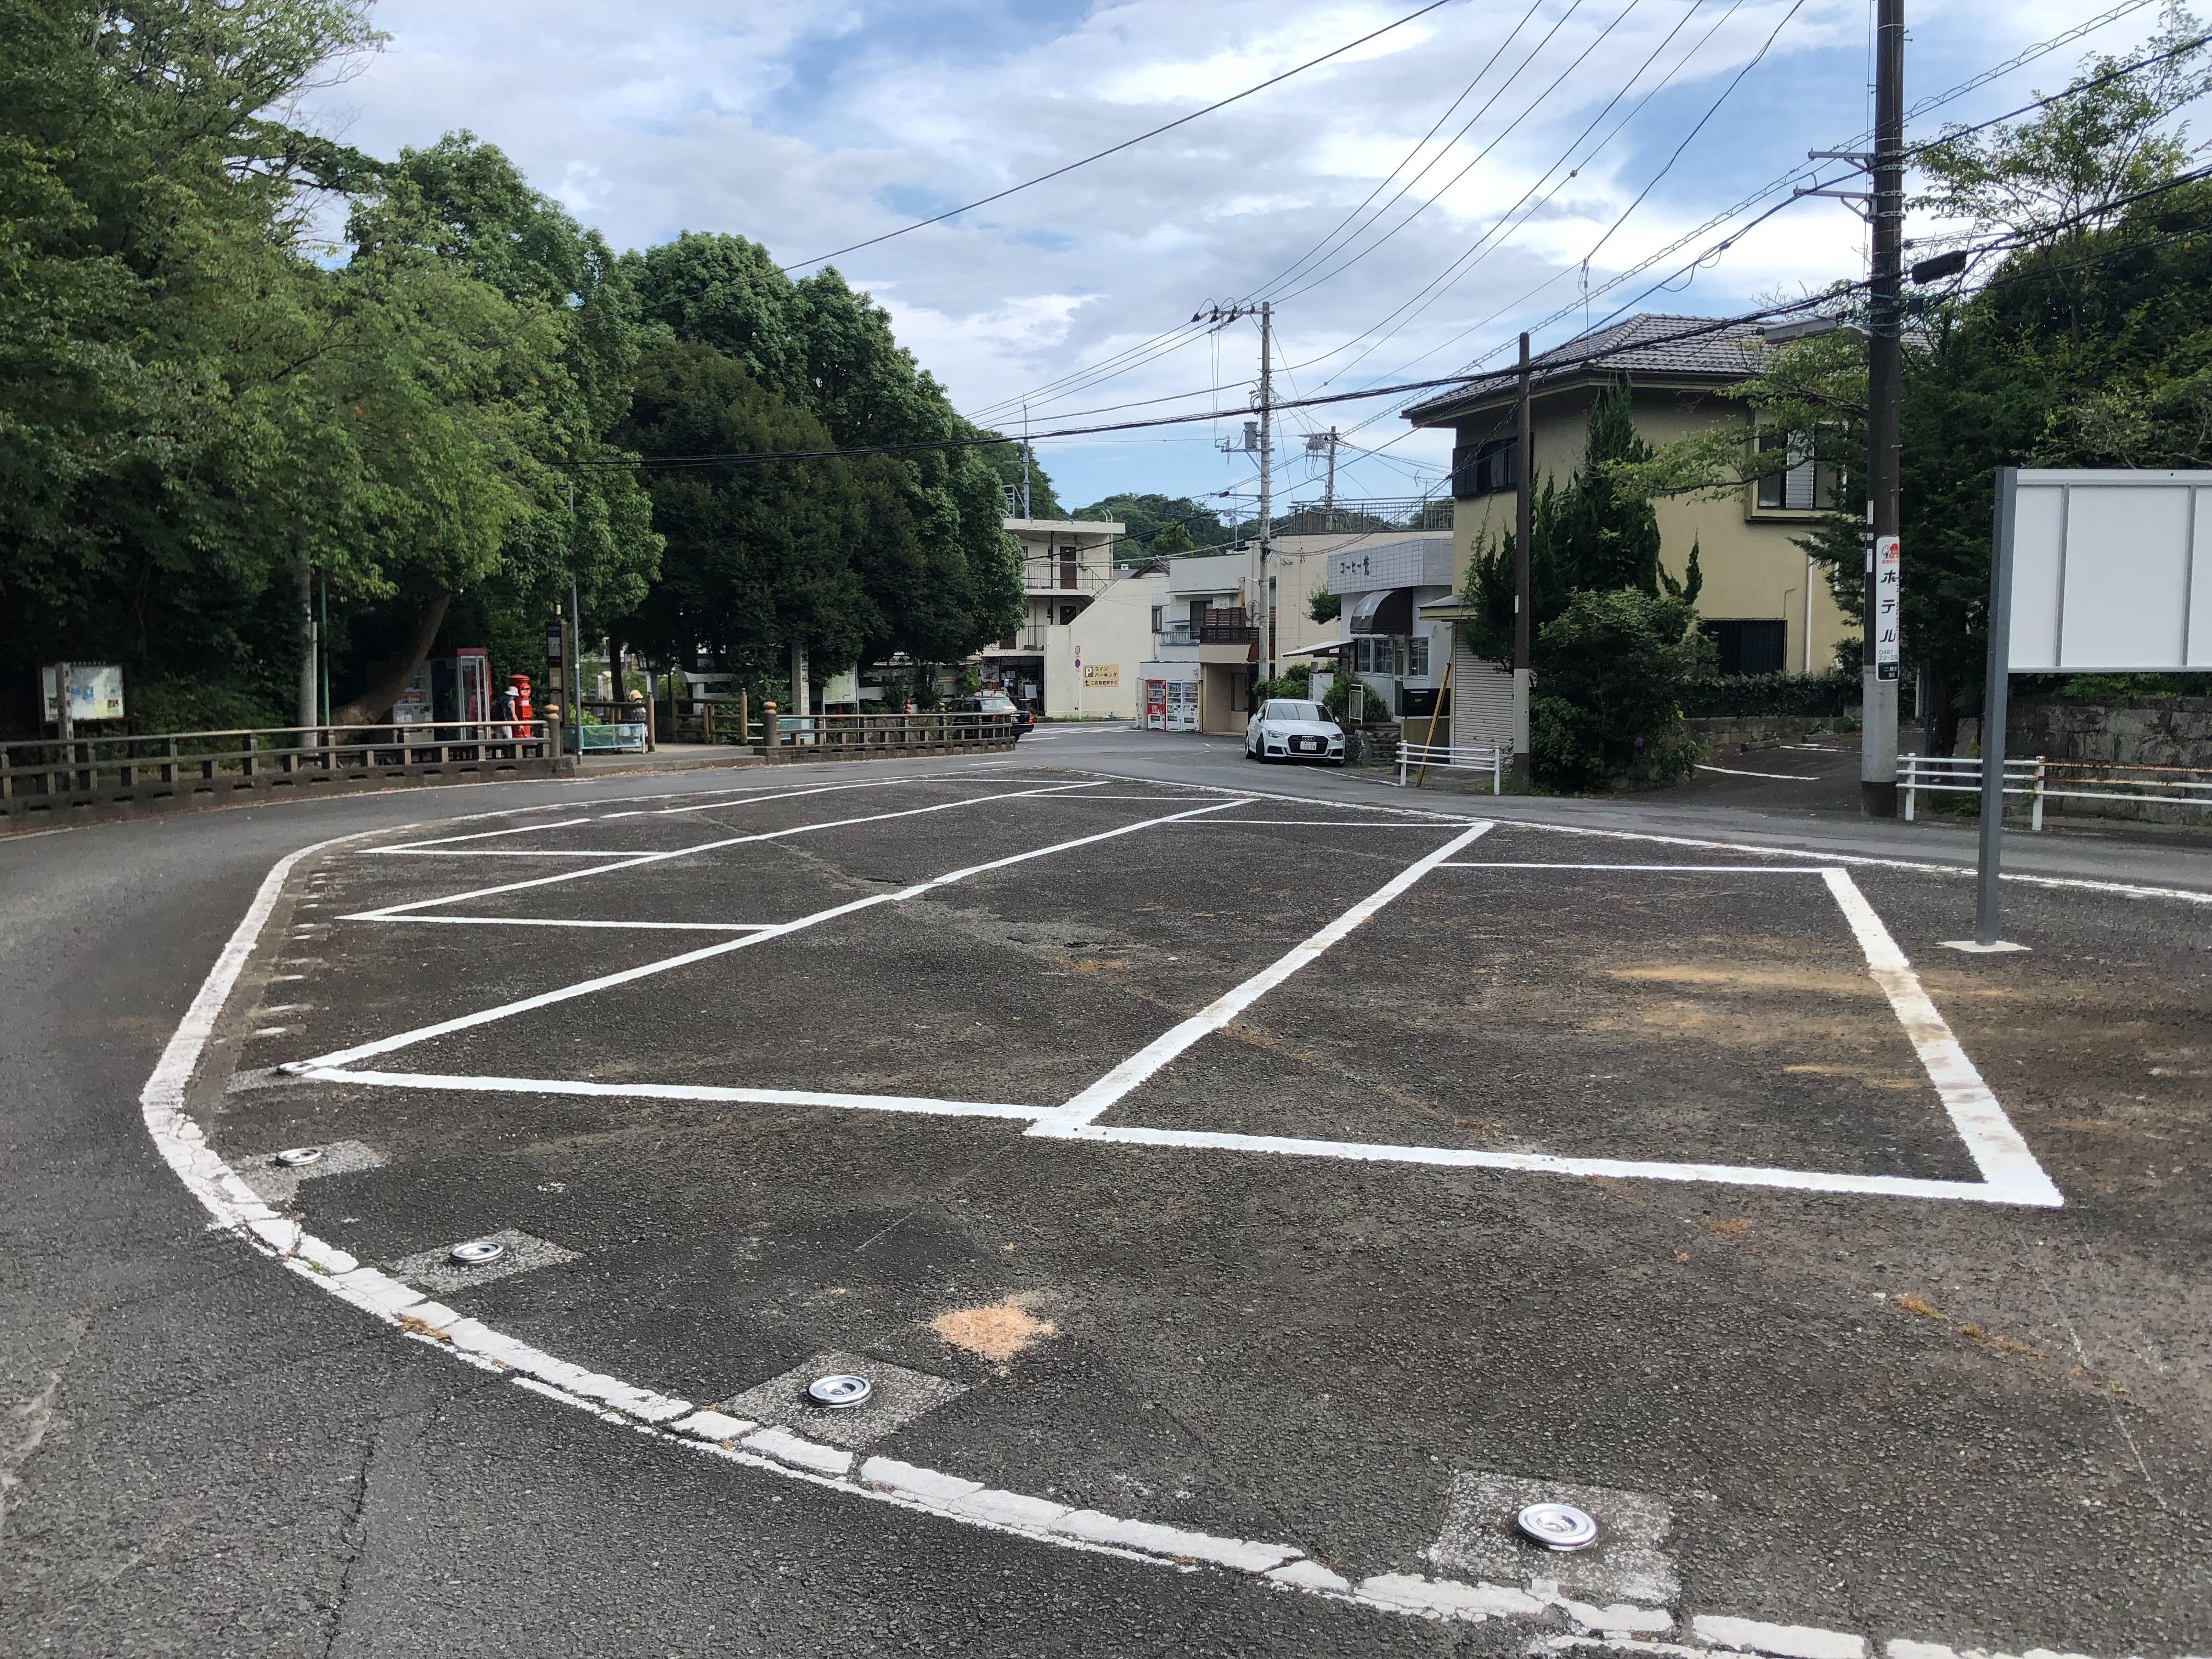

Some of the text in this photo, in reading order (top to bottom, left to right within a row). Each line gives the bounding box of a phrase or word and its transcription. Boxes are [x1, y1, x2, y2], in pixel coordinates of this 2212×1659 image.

[1880, 569, 1896, 643] ホテル
[1086, 667, 1092, 677] P
